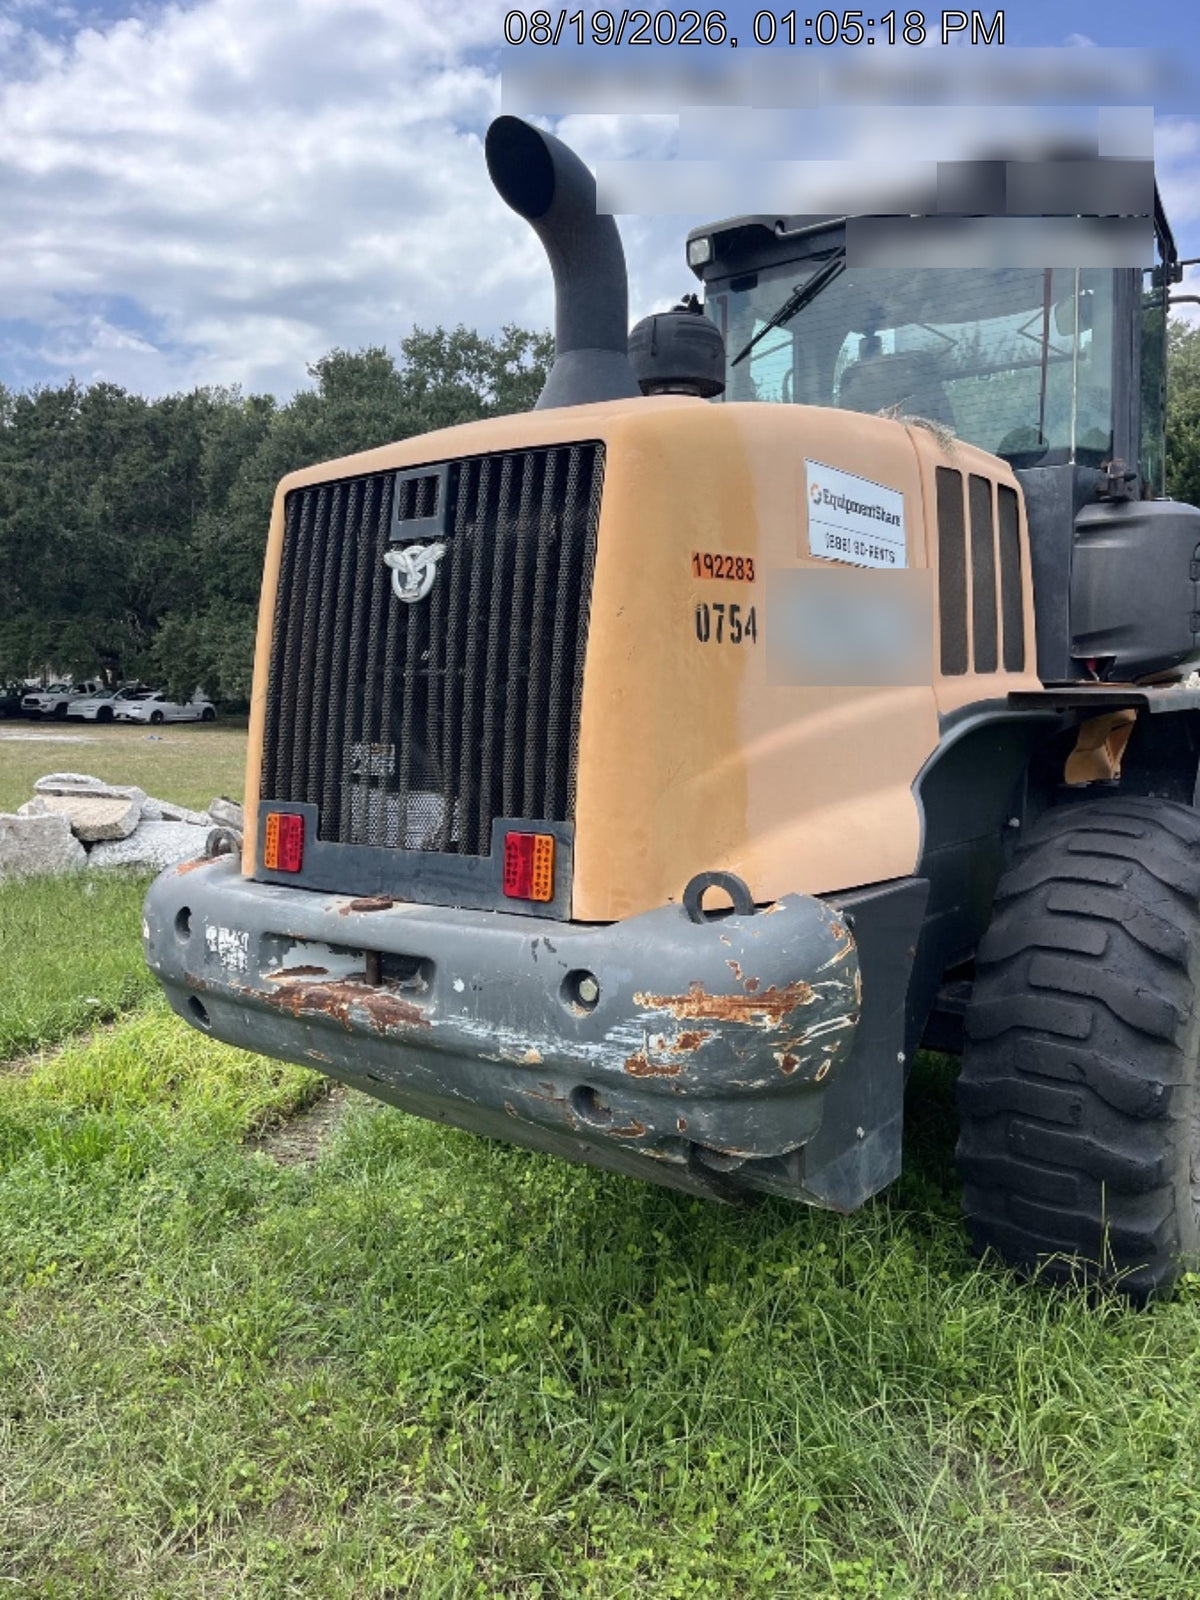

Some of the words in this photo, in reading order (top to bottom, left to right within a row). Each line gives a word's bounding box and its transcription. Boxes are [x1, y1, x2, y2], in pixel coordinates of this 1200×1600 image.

[823, 488, 901, 527] EquipmentShare
[693, 552, 755, 582] 192283
[695, 602, 757, 645] 0754
